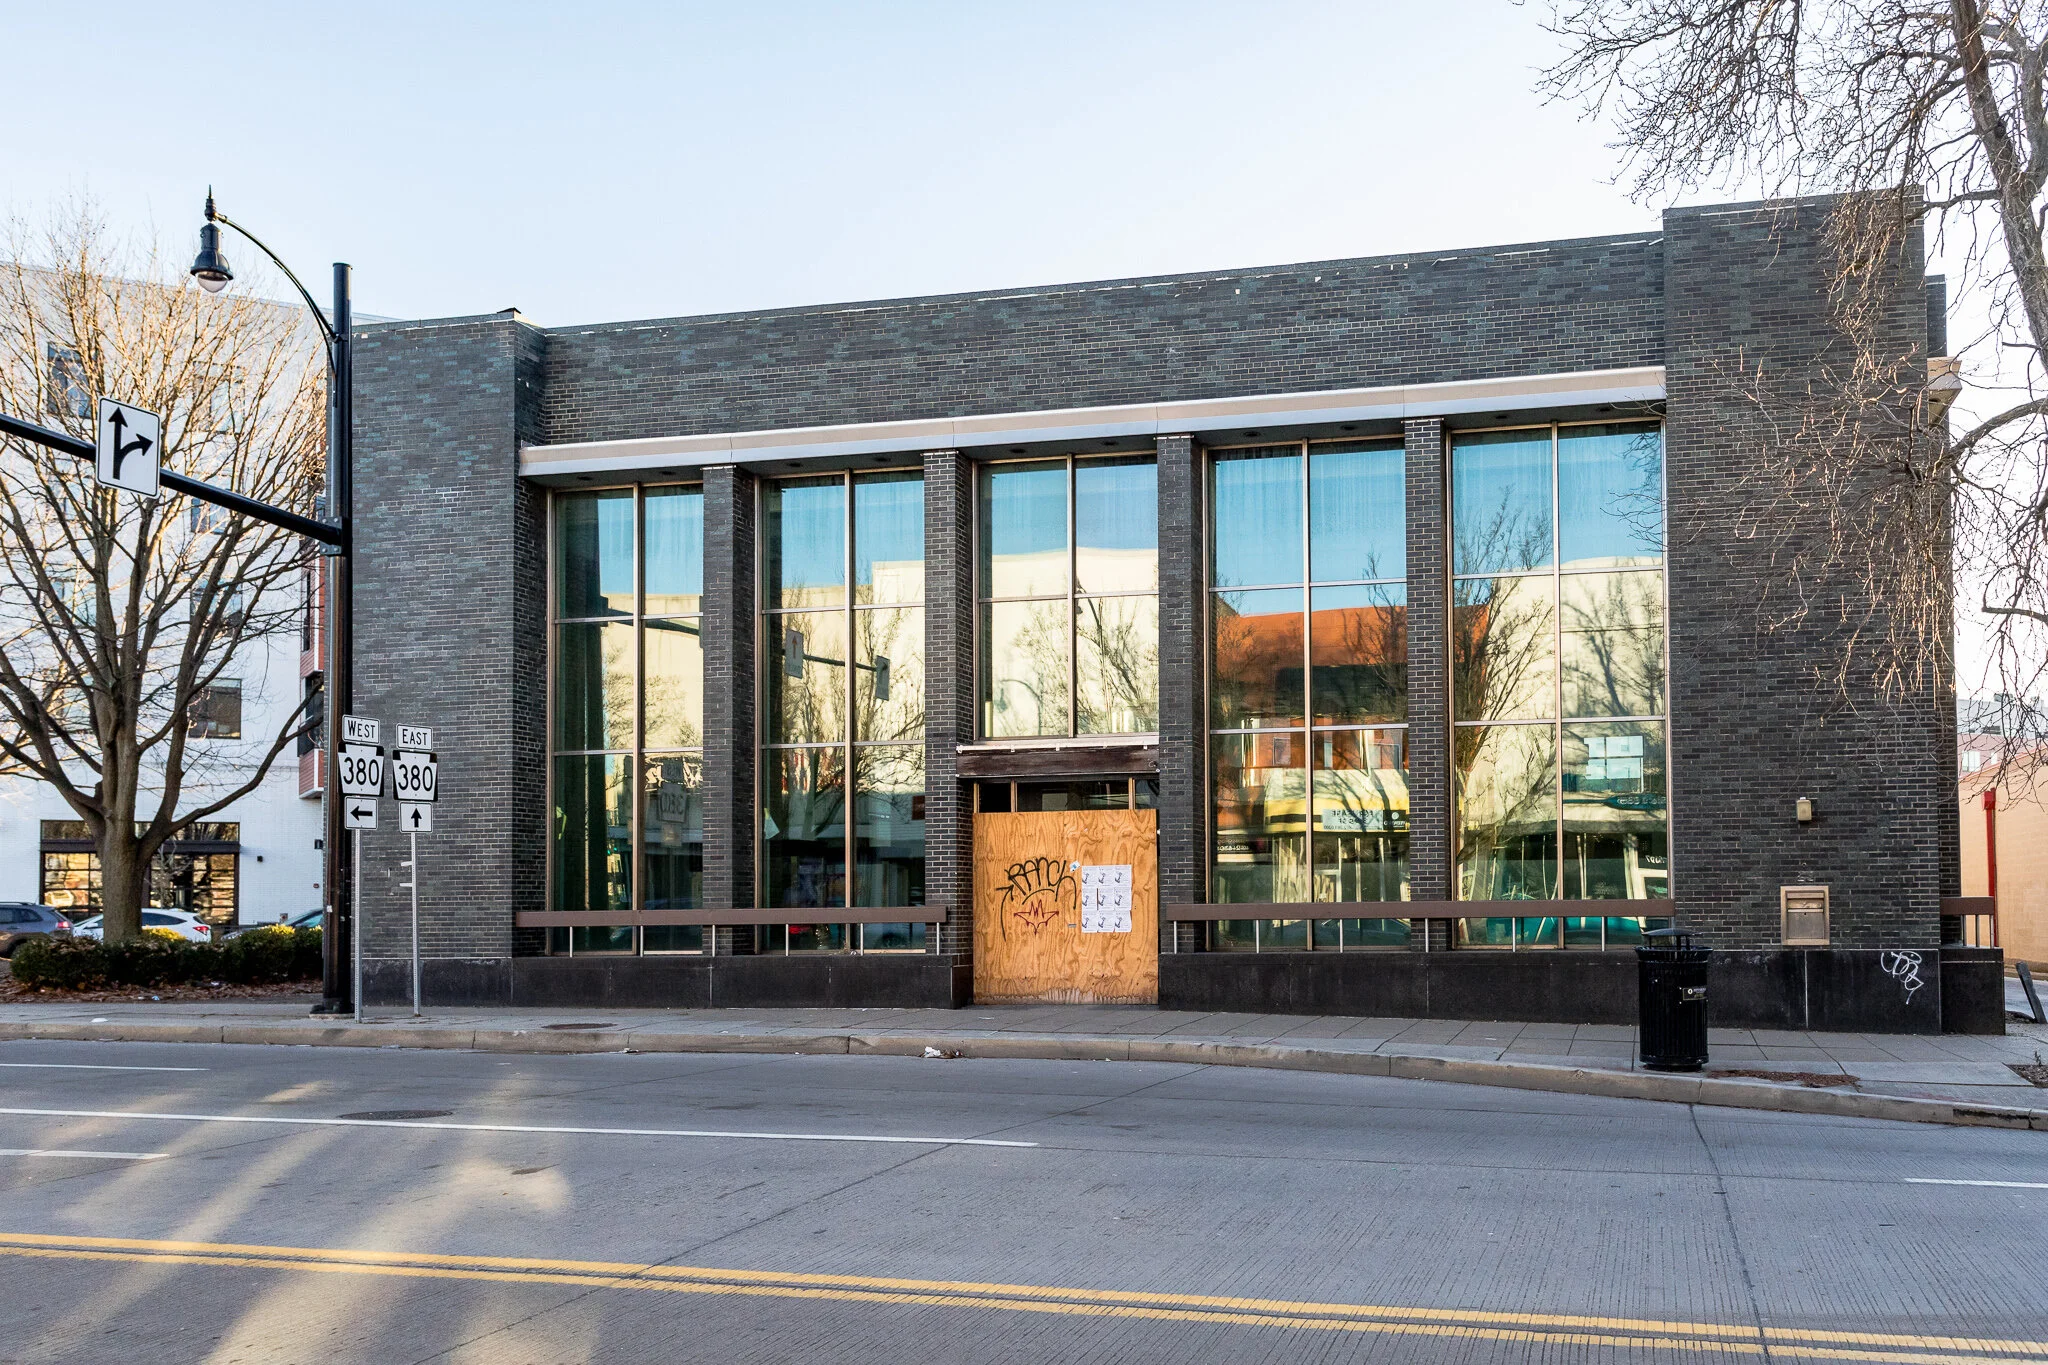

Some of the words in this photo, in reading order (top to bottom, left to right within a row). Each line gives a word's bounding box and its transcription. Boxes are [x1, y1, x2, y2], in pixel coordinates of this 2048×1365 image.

[348, 719, 376, 738] WEST
[402, 729, 428, 745] EAST
[343, 756, 380, 786] 380
[398, 763, 433, 792] 380
